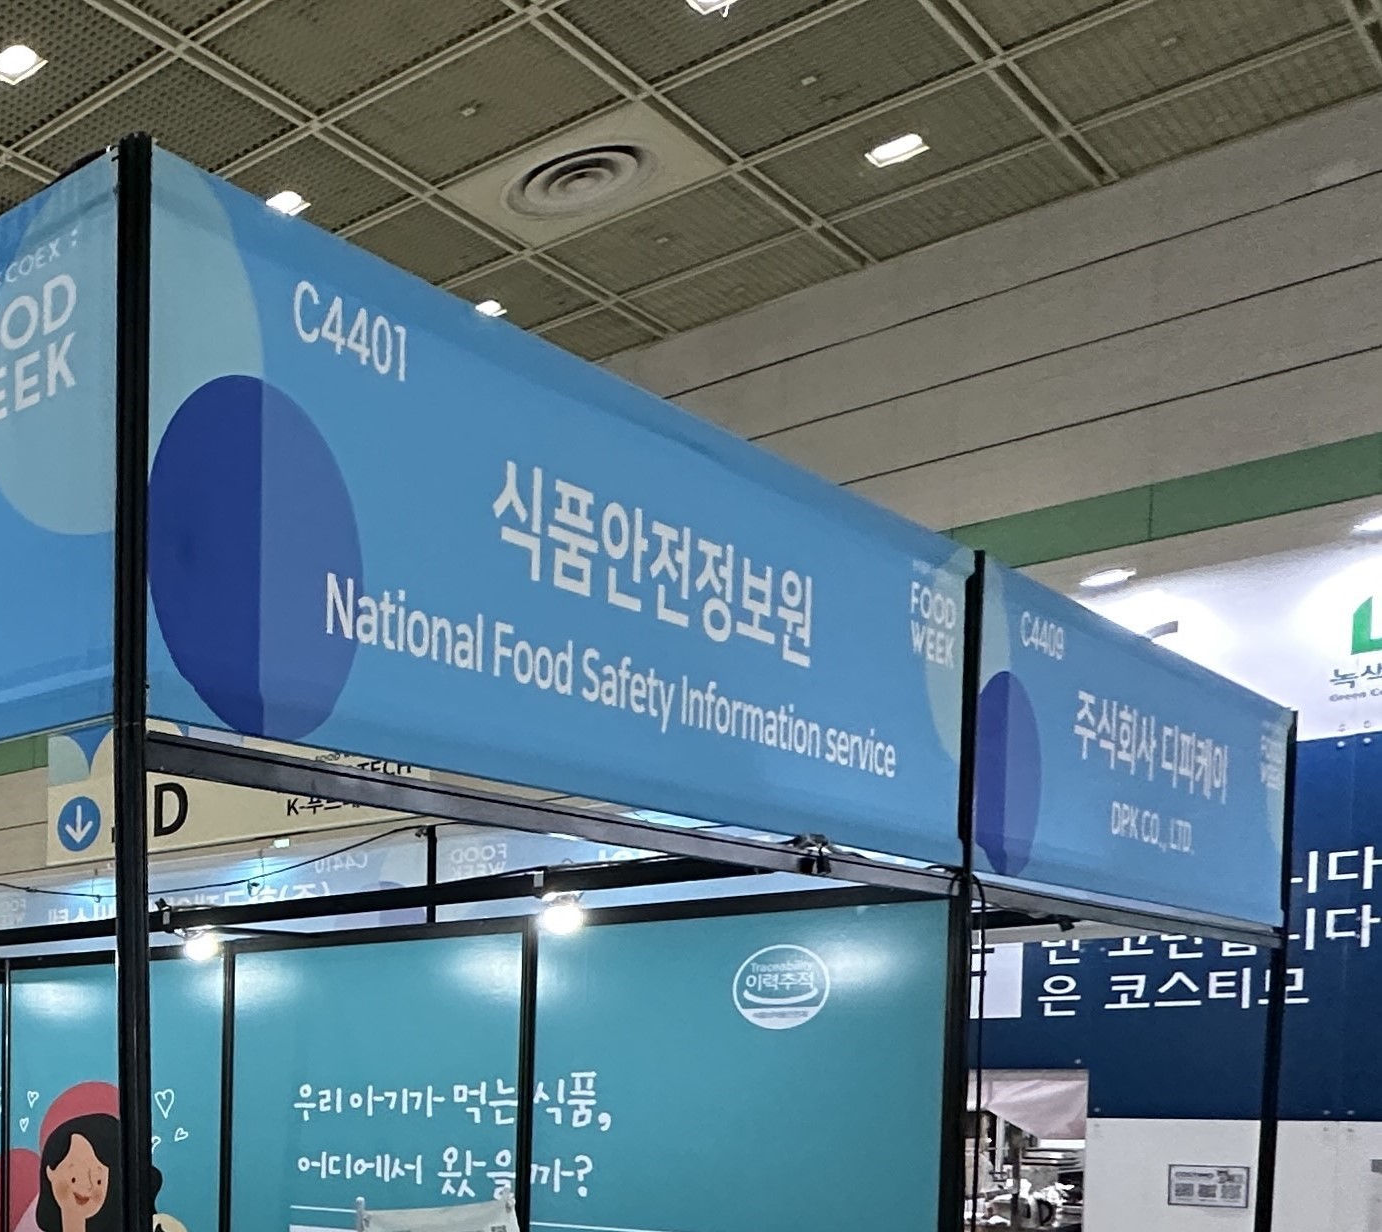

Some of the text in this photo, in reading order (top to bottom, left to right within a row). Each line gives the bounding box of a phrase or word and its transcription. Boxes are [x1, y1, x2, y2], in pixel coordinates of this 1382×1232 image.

[5, 237, 61, 284] COEX
[293, 280, 408, 382] C4401
[492, 461, 814, 669] 식품안전정보원
[911, 581, 956, 629] FOOD
[911, 620, 955, 669] WEEK
[1020, 611, 1065, 661] C4409
[325, 572, 897, 780] National Food Safety Information service
[1073, 690, 1157, 782] 주식회사
[1161, 725, 1229, 805] 디피케이
[154, 782, 188, 837] D
[1111, 800, 1138, 838] DPK
[745, 971, 815, 992] 이력추적
[293, 1071, 612, 1131] 우리 아기가 먹는 식품,
[298, 1146, 593, 1198] 어디에서 왔을까?
